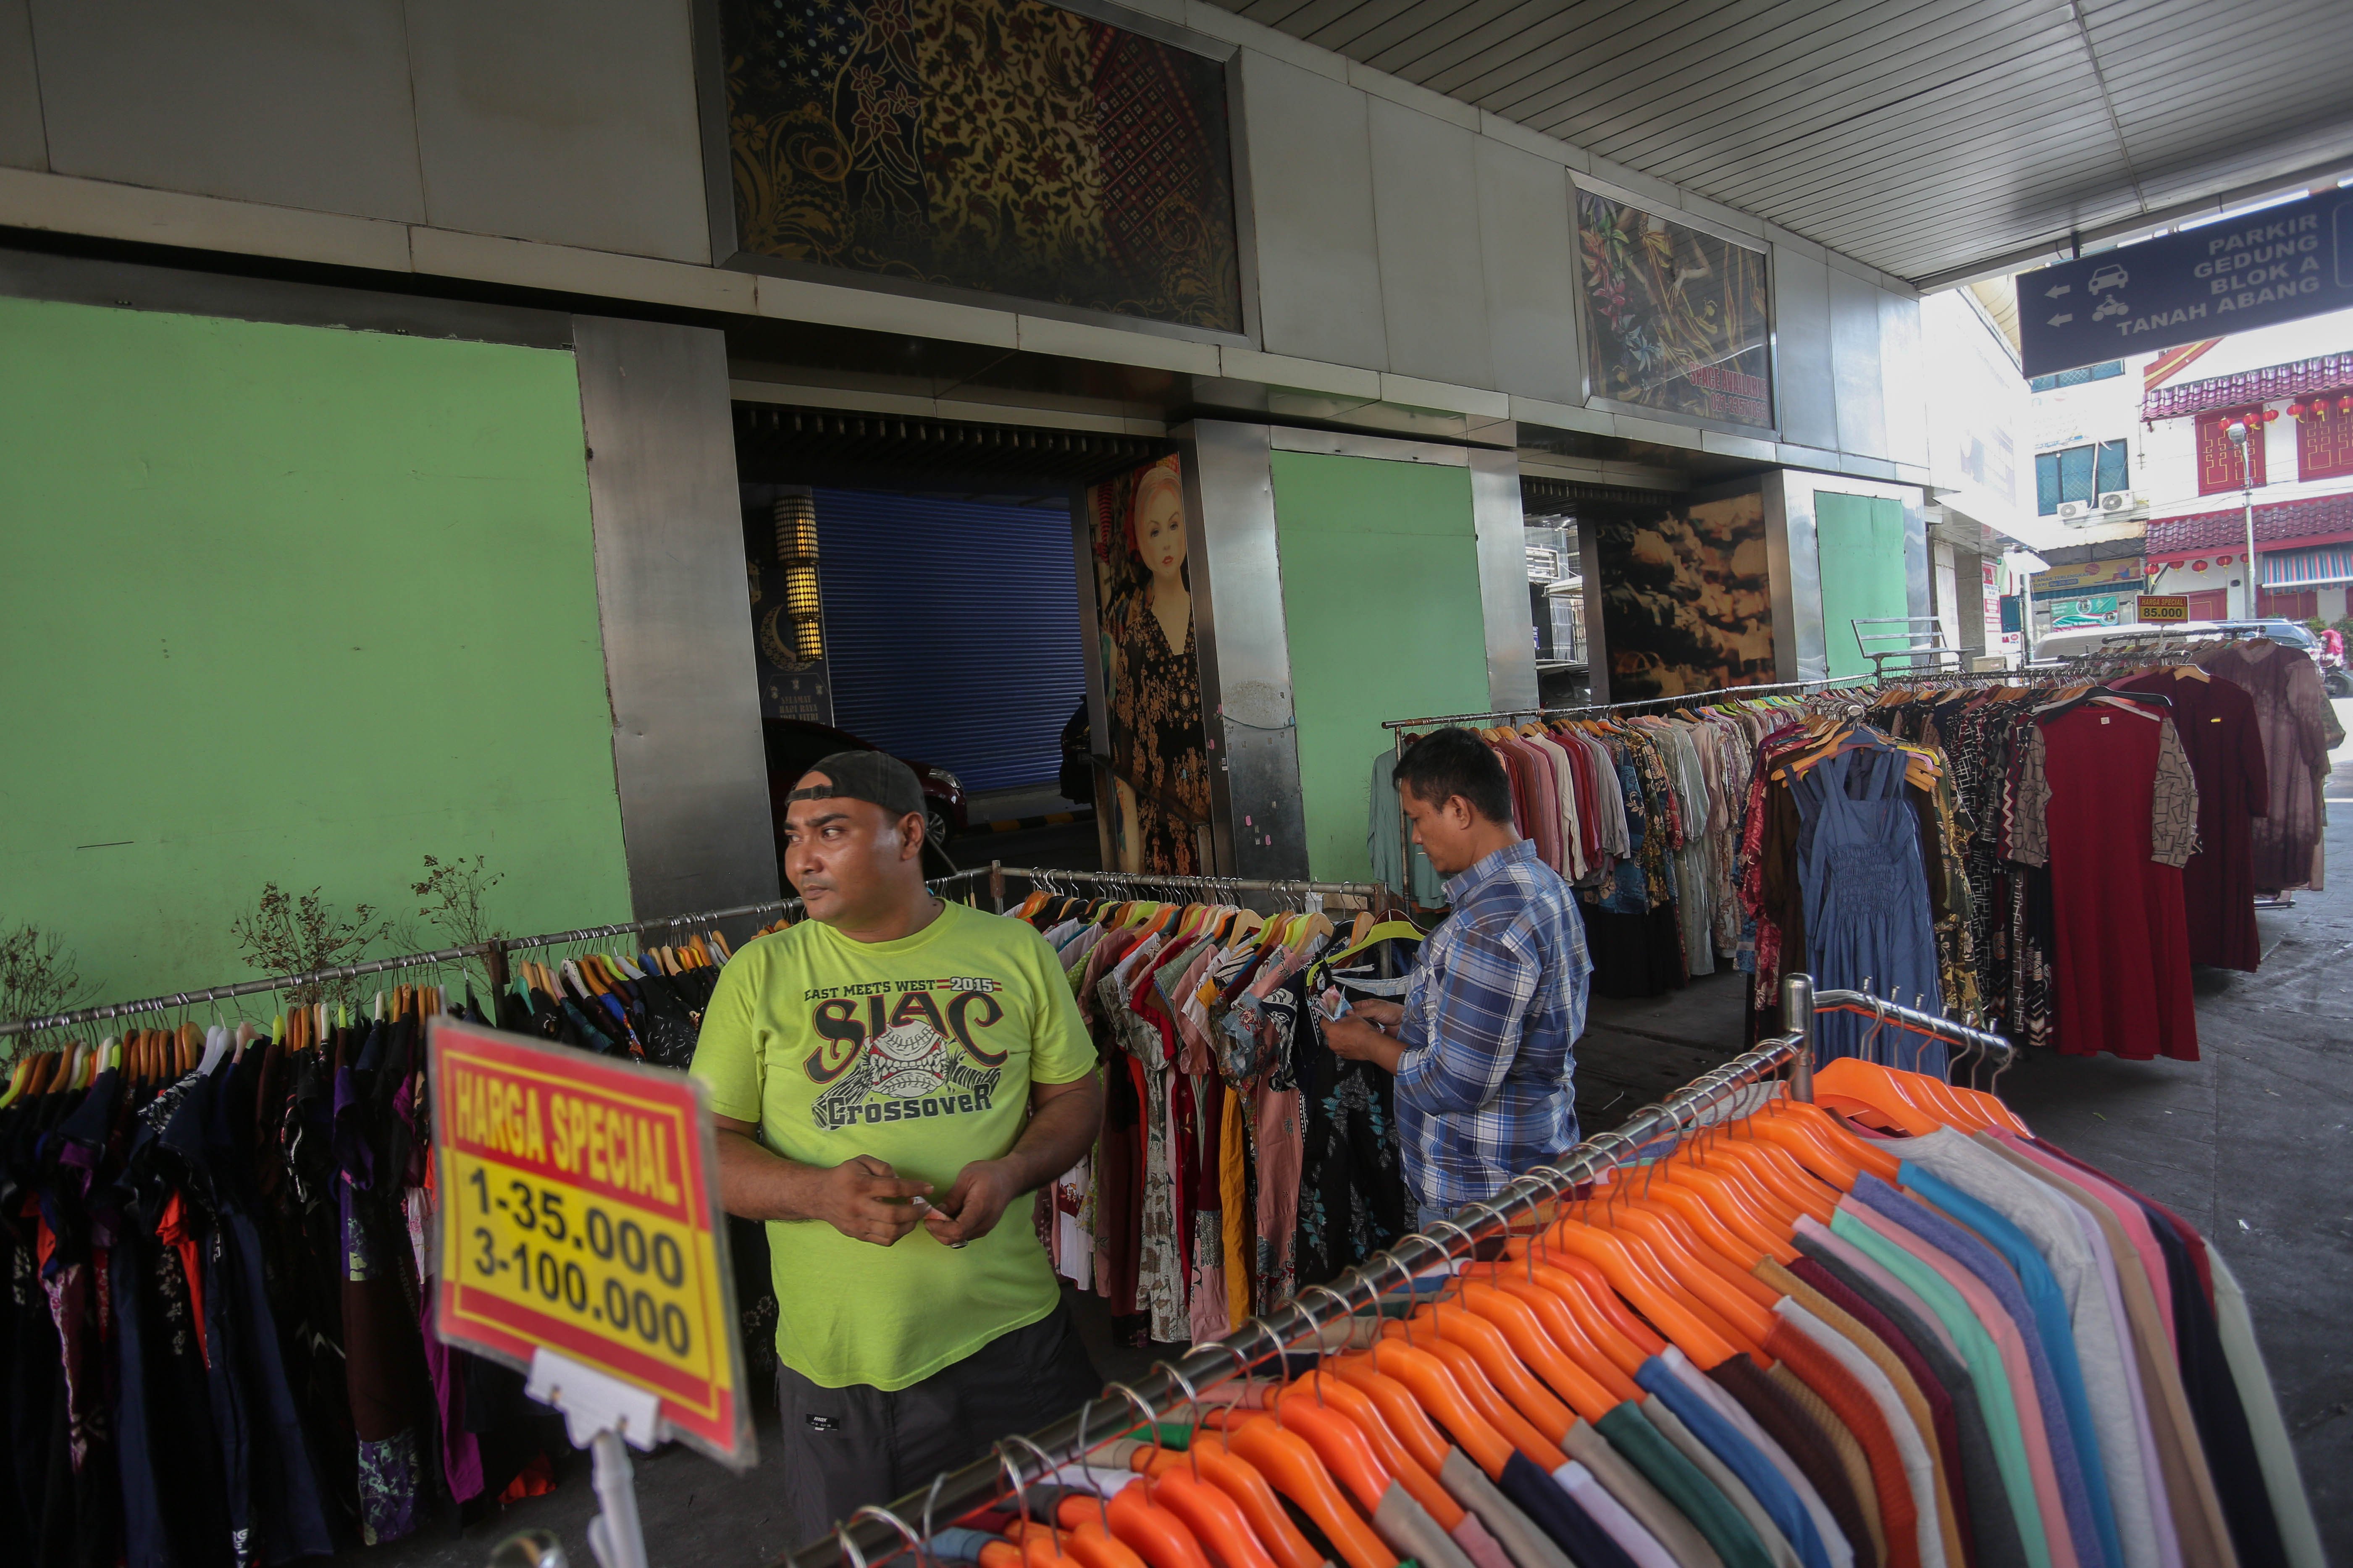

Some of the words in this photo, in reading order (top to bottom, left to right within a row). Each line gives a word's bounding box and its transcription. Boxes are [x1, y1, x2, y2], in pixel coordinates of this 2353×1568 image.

[2209, 214, 2318, 256] PARKIR
[2194, 235, 2319, 278] GEDUNG
[2211, 262, 2289, 295] BLOK
[2299, 256, 2320, 274] A
[2116, 302, 2207, 336] TANAH
[2216, 276, 2320, 314] ABANG
[1689, 361, 1720, 391] SPACE
[1720, 369, 1767, 400] AVAILABLE
[2143, 608, 2182, 617] 85.000
[781, 695, 811, 704] SELAMAT
[800, 704, 818, 713] RAYA
[804, 987, 840, 1002] EAST
[843, 981, 891, 998] MEETS
[894, 979, 936, 992] WEST
[949, 976, 994, 992] 2015
[803, 991, 1008, 1084] SIAC
[455, 1068, 548, 1164] HARGA
[551, 1092, 680, 1206] SPECIAL
[470, 1167, 685, 1288] 1-35.000
[473, 1227, 690, 1358] 3-100.000
